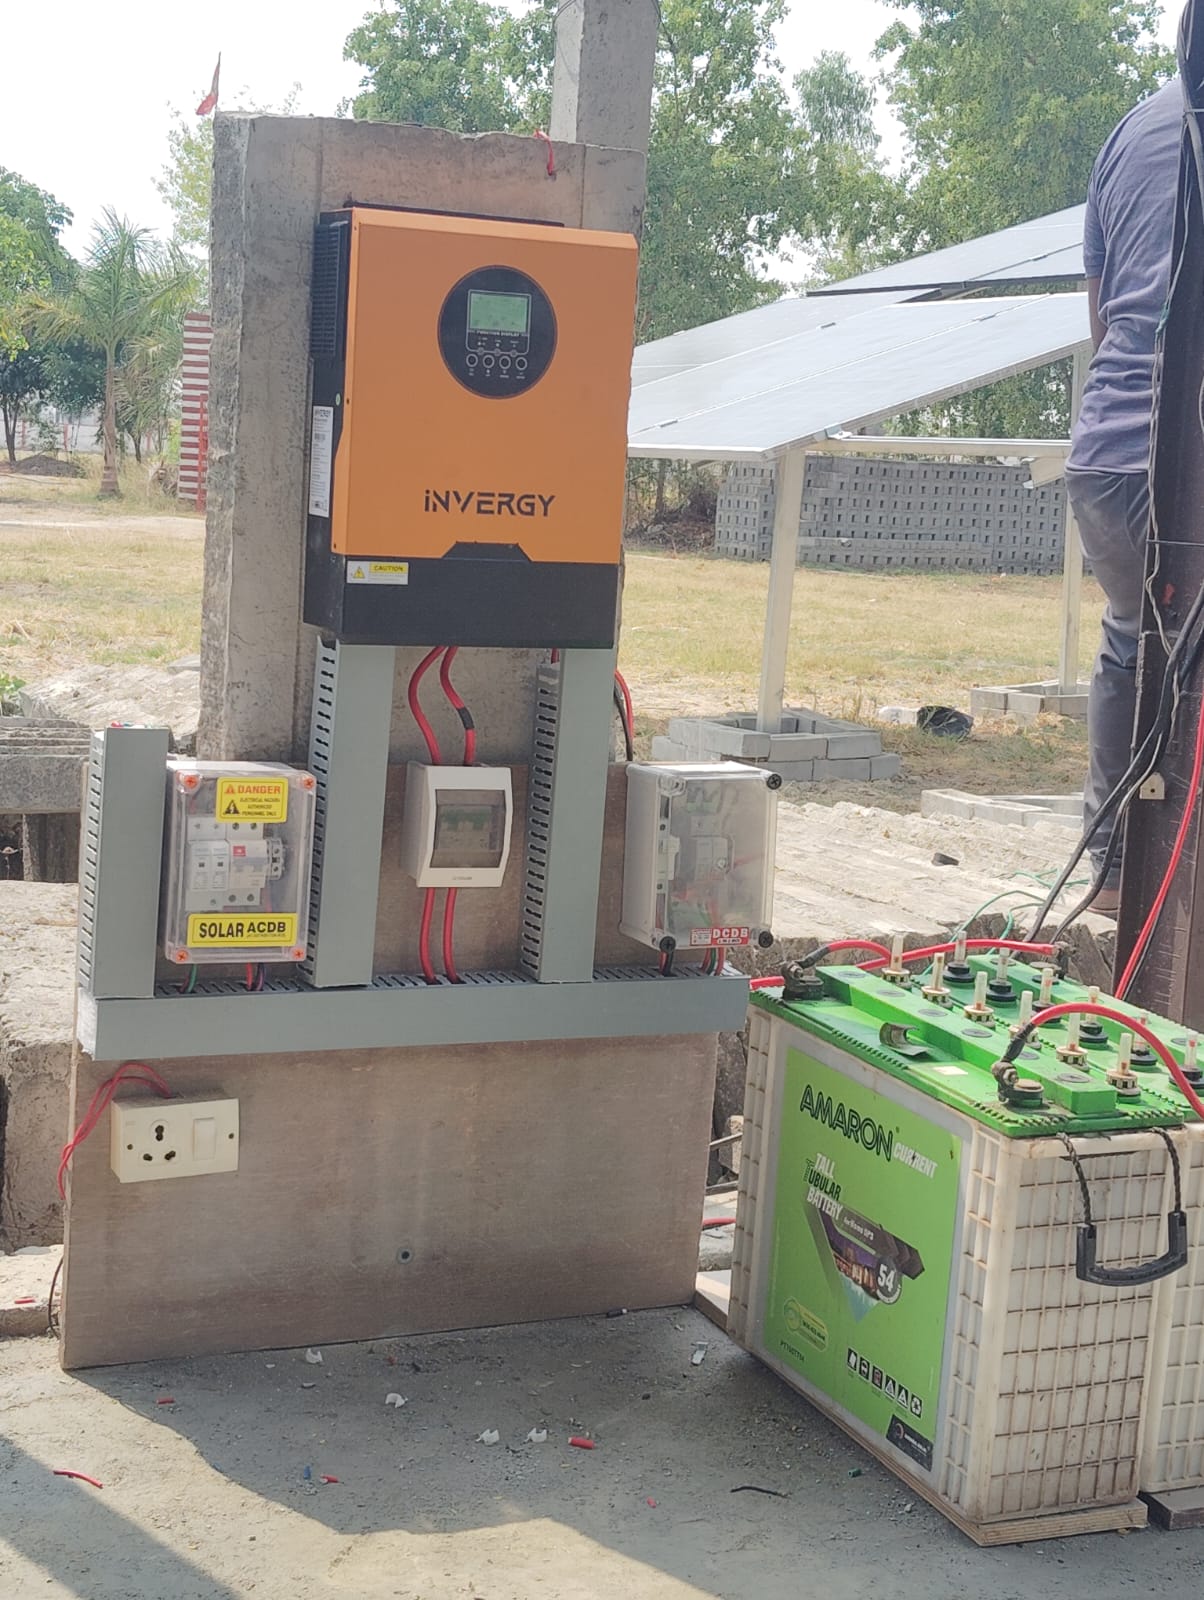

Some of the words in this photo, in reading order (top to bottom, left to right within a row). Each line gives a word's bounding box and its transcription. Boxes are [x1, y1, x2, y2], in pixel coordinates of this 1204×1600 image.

[238, 785, 281, 794] DANGER
[199, 922, 244, 938] SOLAR
[247, 921, 286, 933] ACDB
[712, 928, 748, 938] DCDB
[799, 1084, 893, 1162] AMARON
[815, 1152, 836, 1179] TALL
[893, 1142, 938, 1178] CURRENT
[806, 1187, 843, 1221] BATTERY
[877, 1263, 895, 1293] 54
